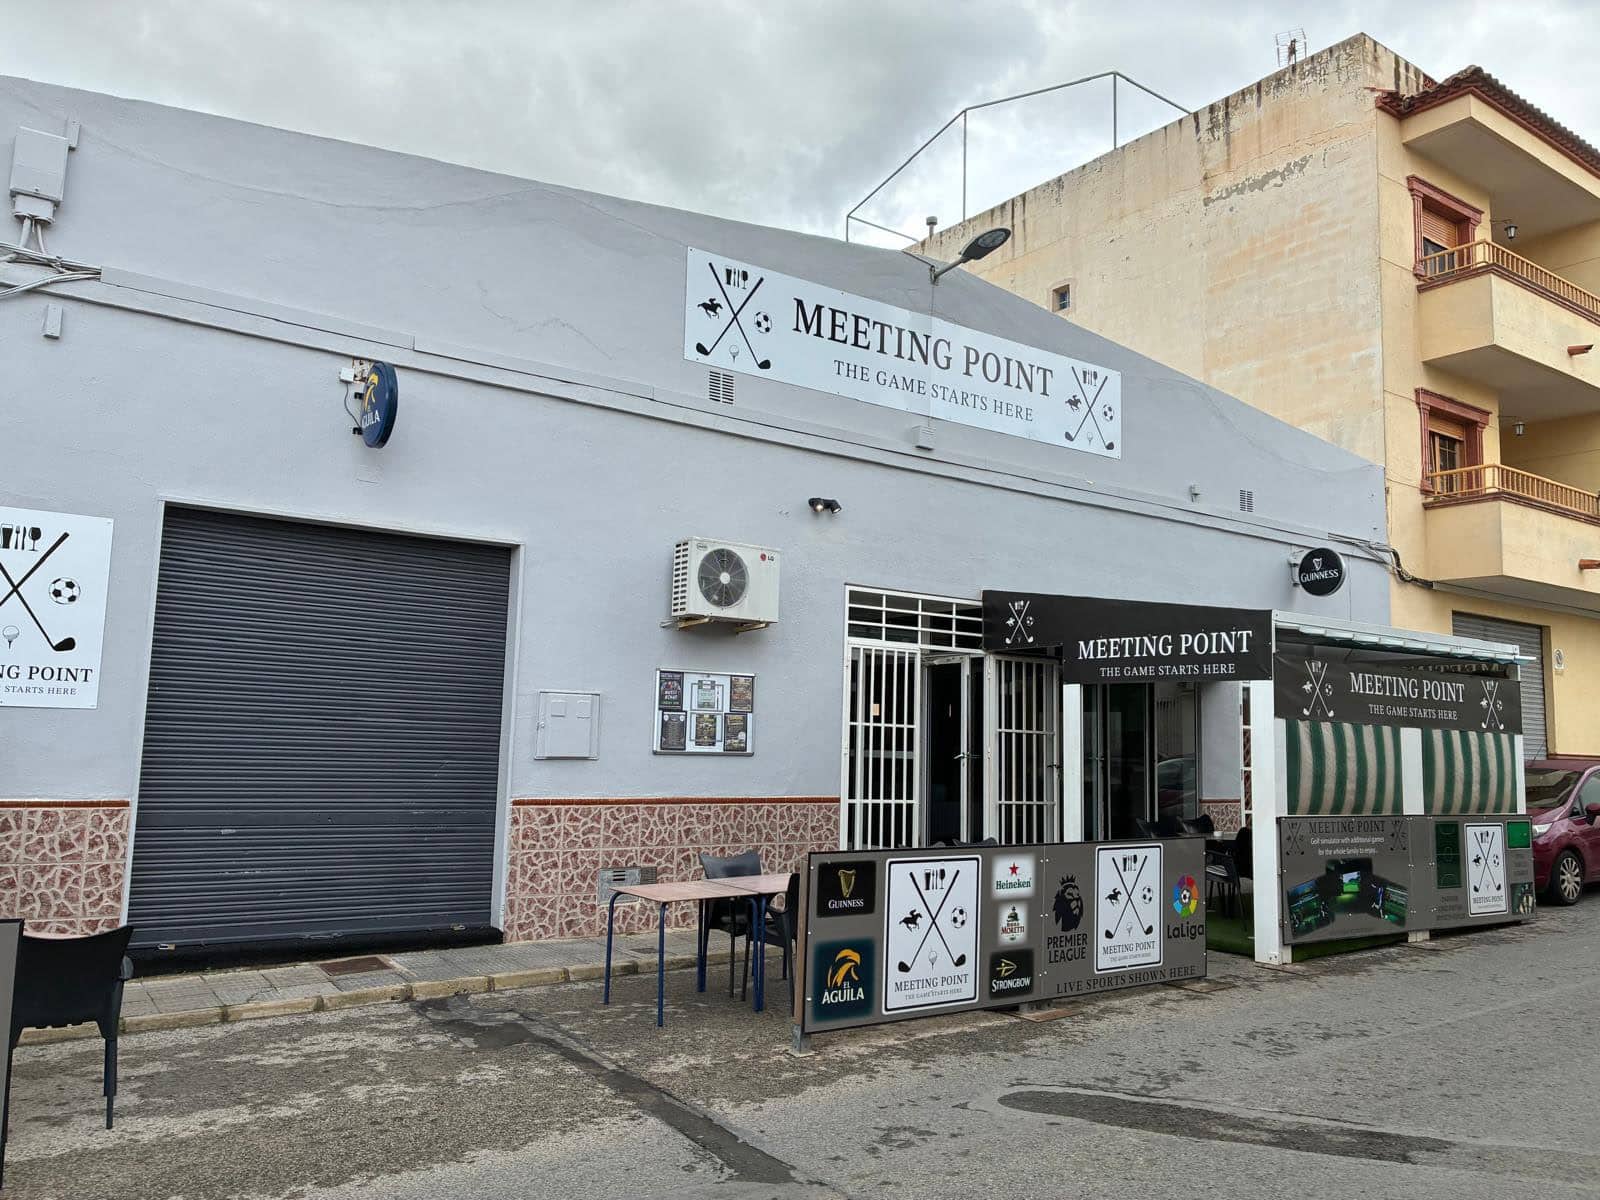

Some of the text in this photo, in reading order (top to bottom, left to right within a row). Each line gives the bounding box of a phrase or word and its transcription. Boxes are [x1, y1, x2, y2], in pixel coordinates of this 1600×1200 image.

[792, 297, 1053, 397] MEETING POINT
[834, 359, 1033, 422] THE GAME STARTS HERE
[1300, 569, 1339, 583] GUINNESS
[1078, 630, 1252, 660] MEETING POINT
[28, 665, 93, 682] POINT
[1100, 663, 1236, 677] THE GAME STARTS HERE
[4, 685, 77, 695] STARTS HERE
[1350, 672, 1465, 703] MEETING POINT
[1368, 704, 1458, 720] THE GAME STARTS HERE
[1309, 820, 1385, 834] MEETING POINT
[1311, 837, 1320, 845] Golf
[1350, 836, 1371, 844] additional
[1371, 837, 1385, 845] games
[1346, 848, 1359, 856] family
[995, 878, 1032, 890] Heineken
[828, 898, 864, 909] GUINNESS
[1001, 926, 1025, 935] MORETTI
[1167, 922, 1205, 940] LaLiga
[1047, 933, 1088, 949] PREMIER
[1102, 941, 1156, 955] MEETING POINT
[1048, 947, 1086, 964] LEAGUE
[843, 981, 850, 989] EL
[894, 973, 969, 993] MEETING POINT
[992, 977, 1032, 992] STRONGBOW
[1056, 965, 1197, 994] LIVE SPORTS SHOWN HERE
